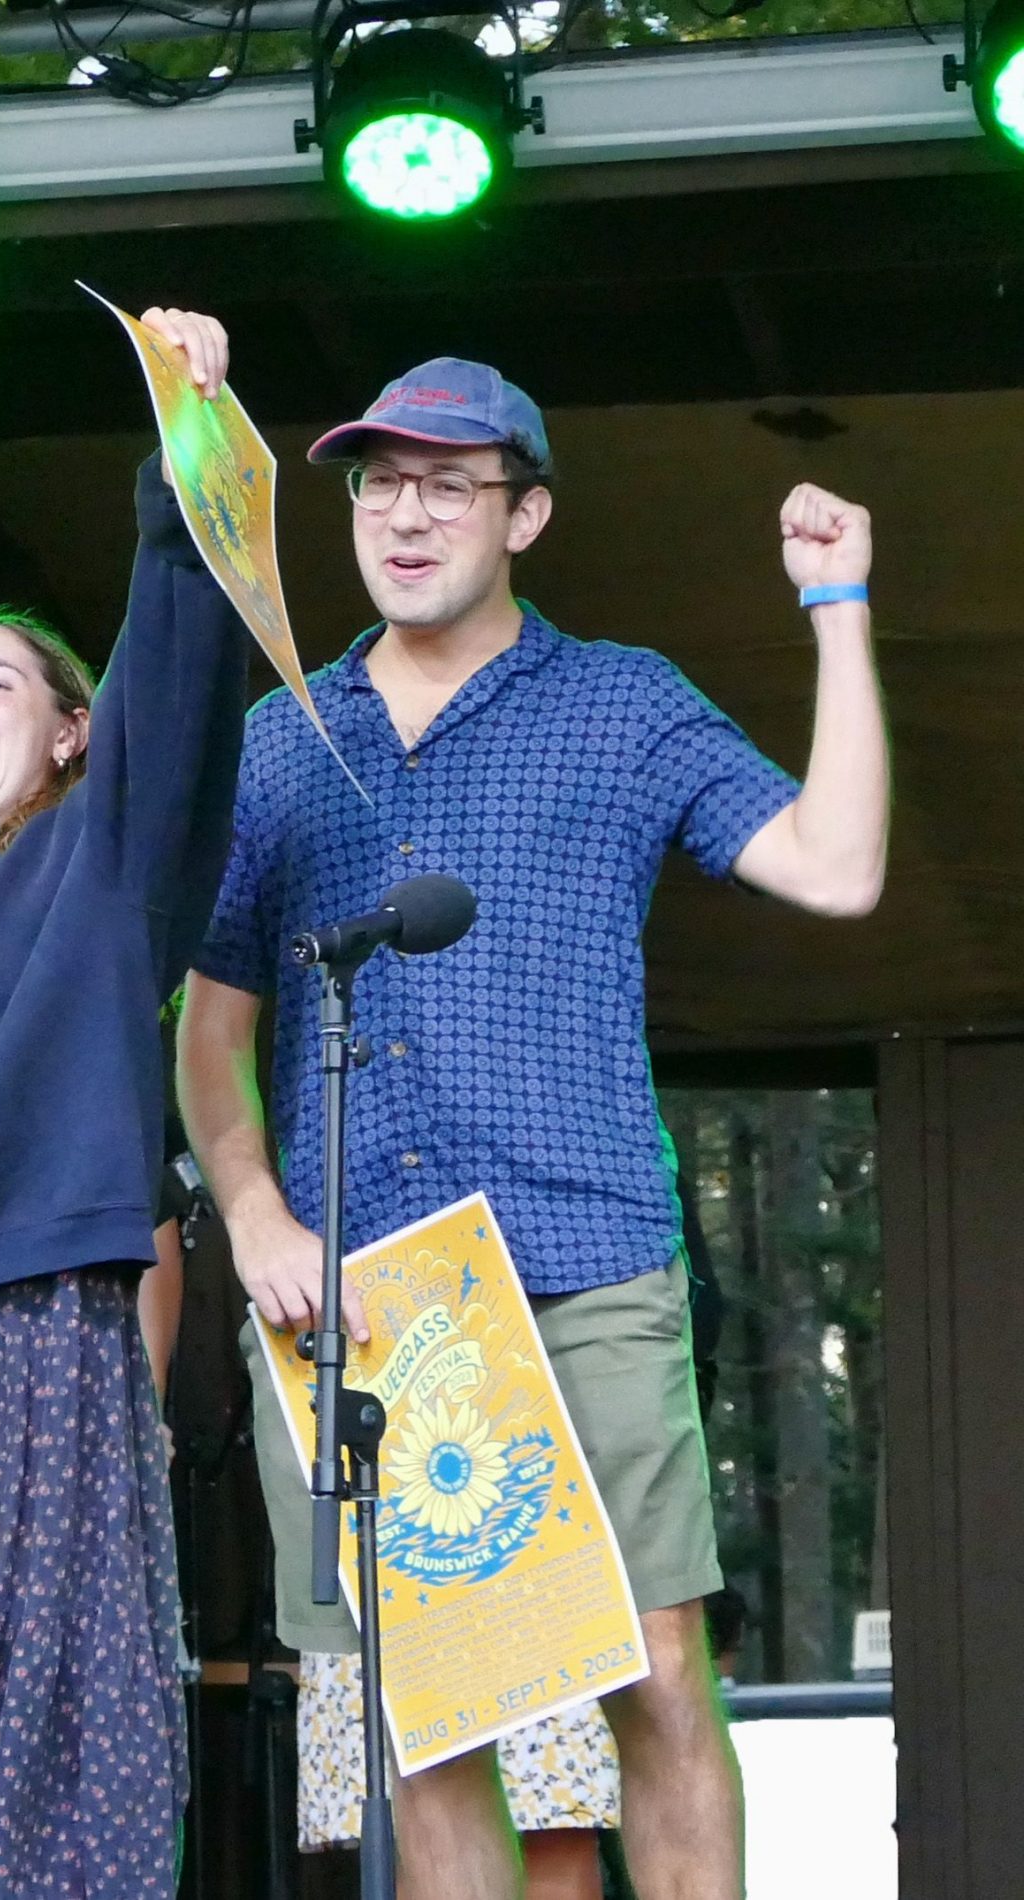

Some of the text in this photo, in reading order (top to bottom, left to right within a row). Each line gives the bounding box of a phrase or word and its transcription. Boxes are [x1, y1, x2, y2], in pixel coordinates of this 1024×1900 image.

[361, 1266, 417, 1288] OMAS
[411, 1279, 452, 1305] BEACH
[378, 1312, 449, 1401] UEGRASS
[414, 1347, 471, 1400] FESTIVAL
[517, 1460, 548, 1481] 1979
[497, 1503, 536, 1550] MAINE
[402, 1718, 449, 1753] AUG
[454, 1707, 477, 1731] 31
[496, 1675, 548, 1714] SEPT
[582, 1641, 636, 1679] 2023
